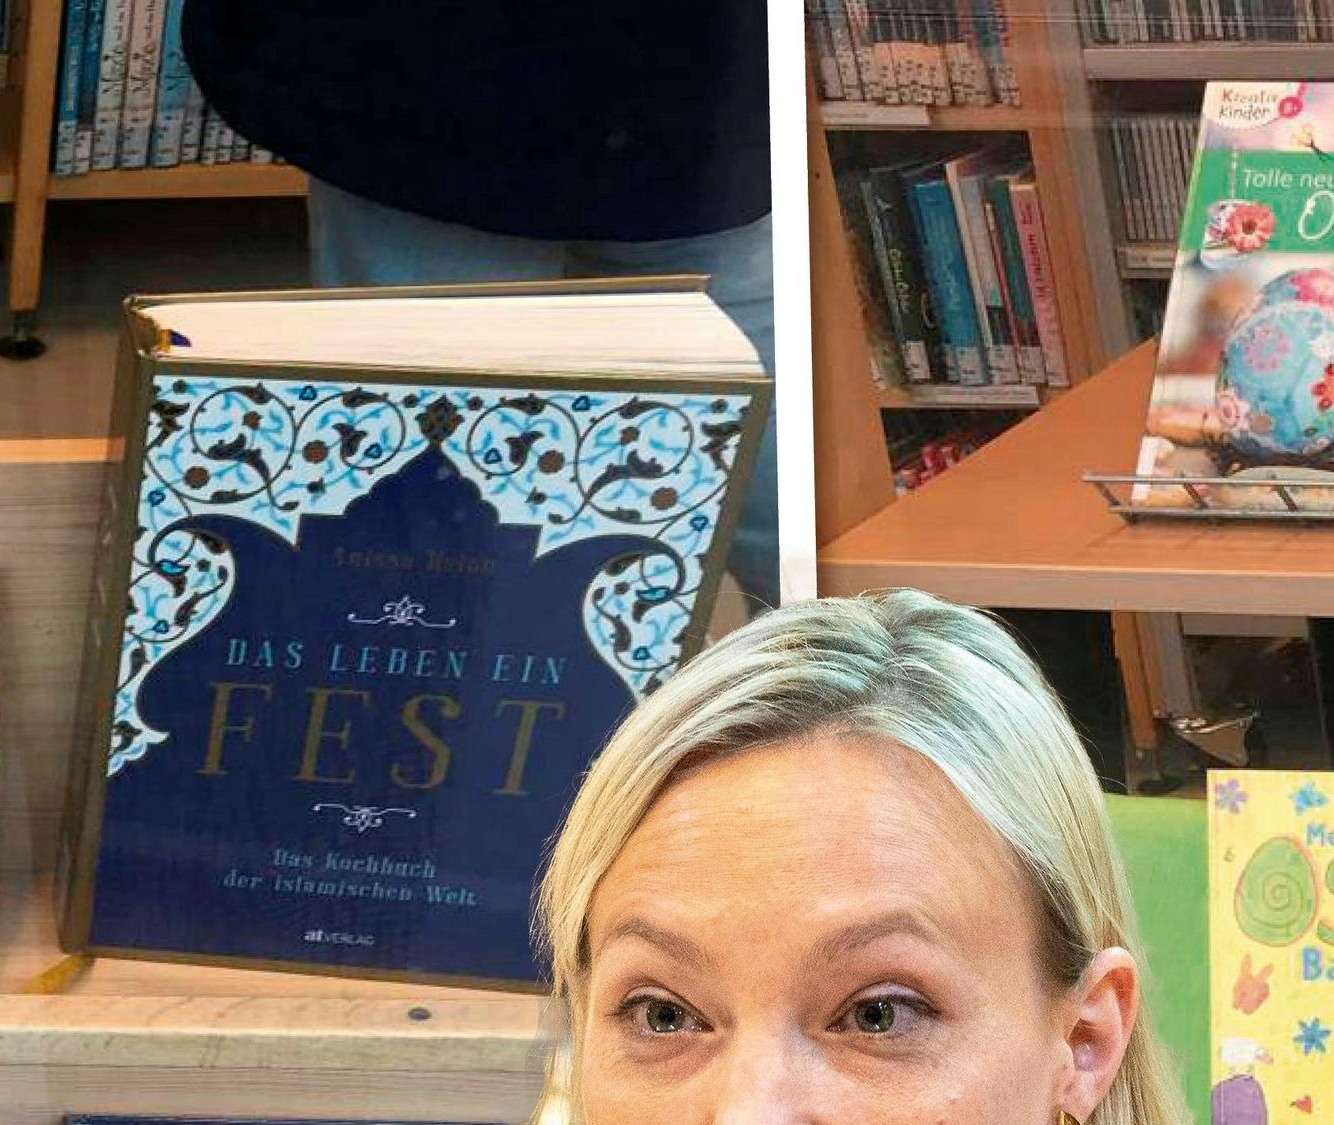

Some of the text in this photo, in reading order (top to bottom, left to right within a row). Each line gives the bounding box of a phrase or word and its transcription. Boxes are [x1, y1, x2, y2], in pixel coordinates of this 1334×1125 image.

[1243, 170, 1293, 189] Tolle
[227, 638, 568, 686] DAS LEBEN EIN
[196, 680, 568, 797] FEST
[273, 848, 437, 879] Das Kochbuch
[224, 869, 477, 906] der islamischen Welt
